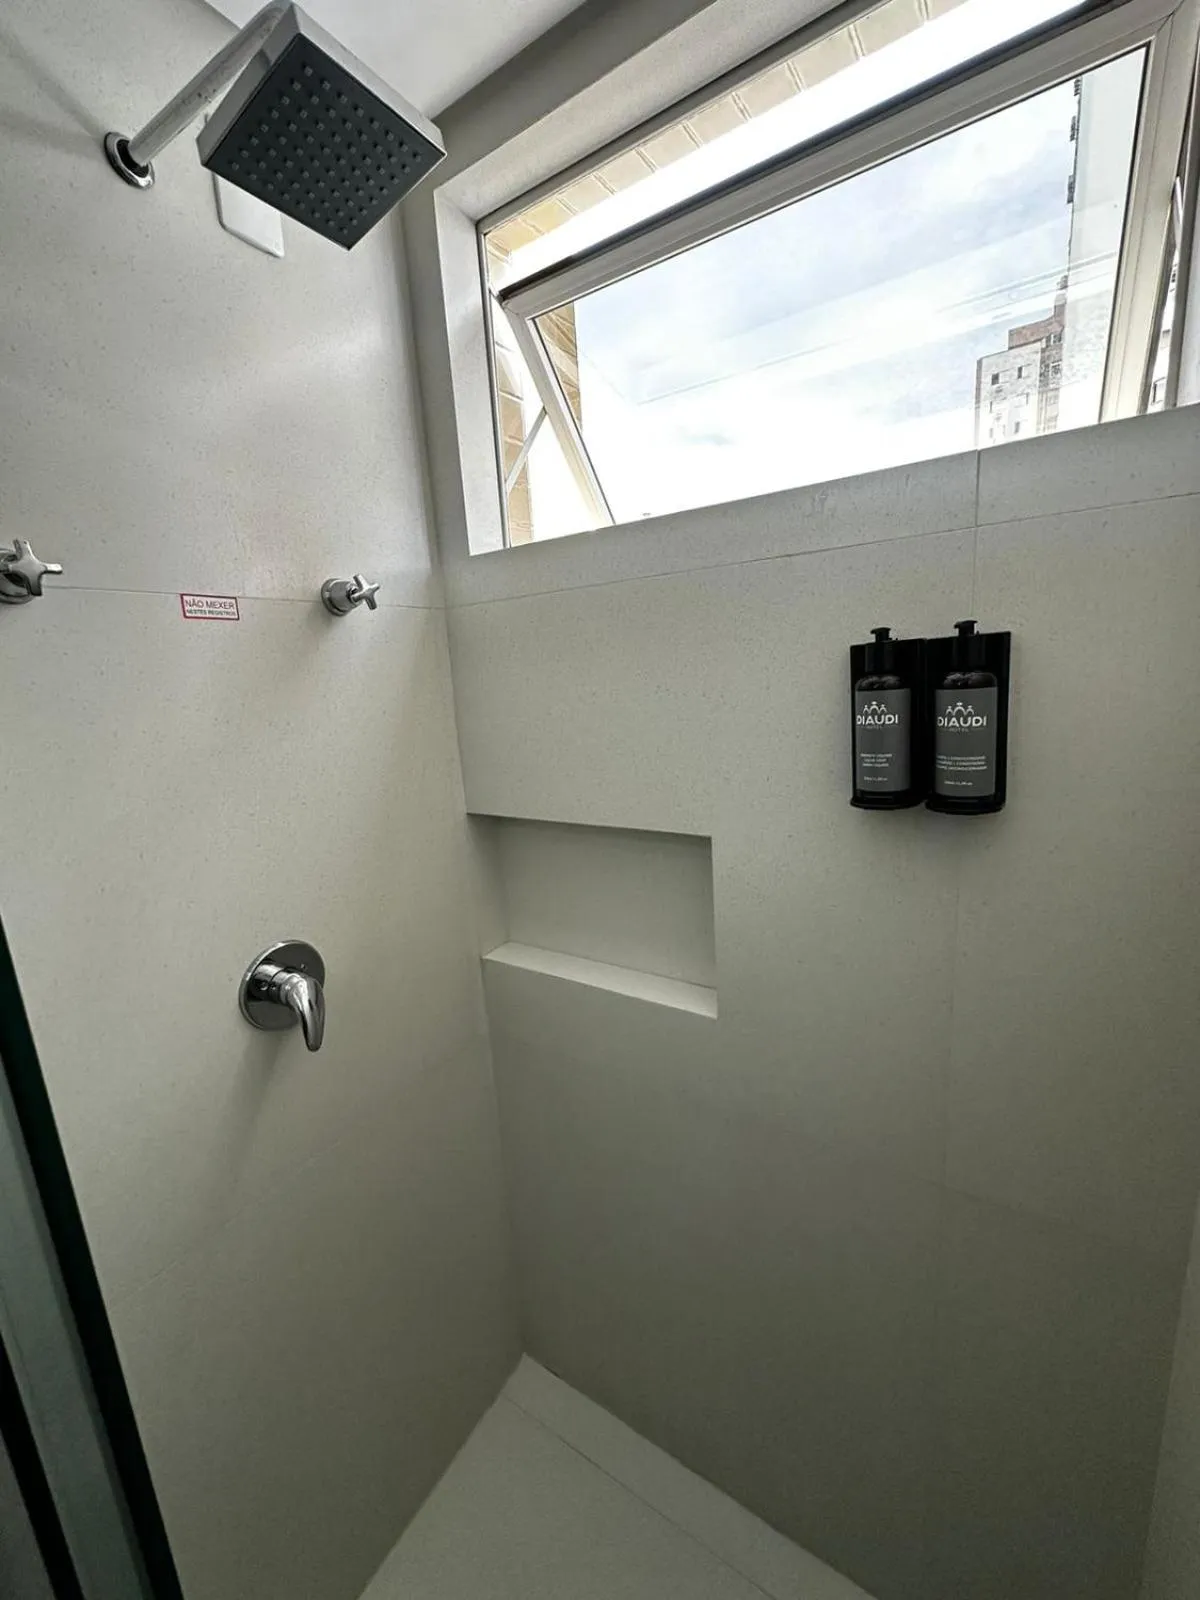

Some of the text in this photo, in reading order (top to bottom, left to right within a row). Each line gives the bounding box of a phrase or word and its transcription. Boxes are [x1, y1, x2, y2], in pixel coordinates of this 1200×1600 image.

[185, 598, 235, 609] NÃO MEXER
[856, 714, 899, 725] DIAUDI
[937, 716, 987, 727] DIAUDI
